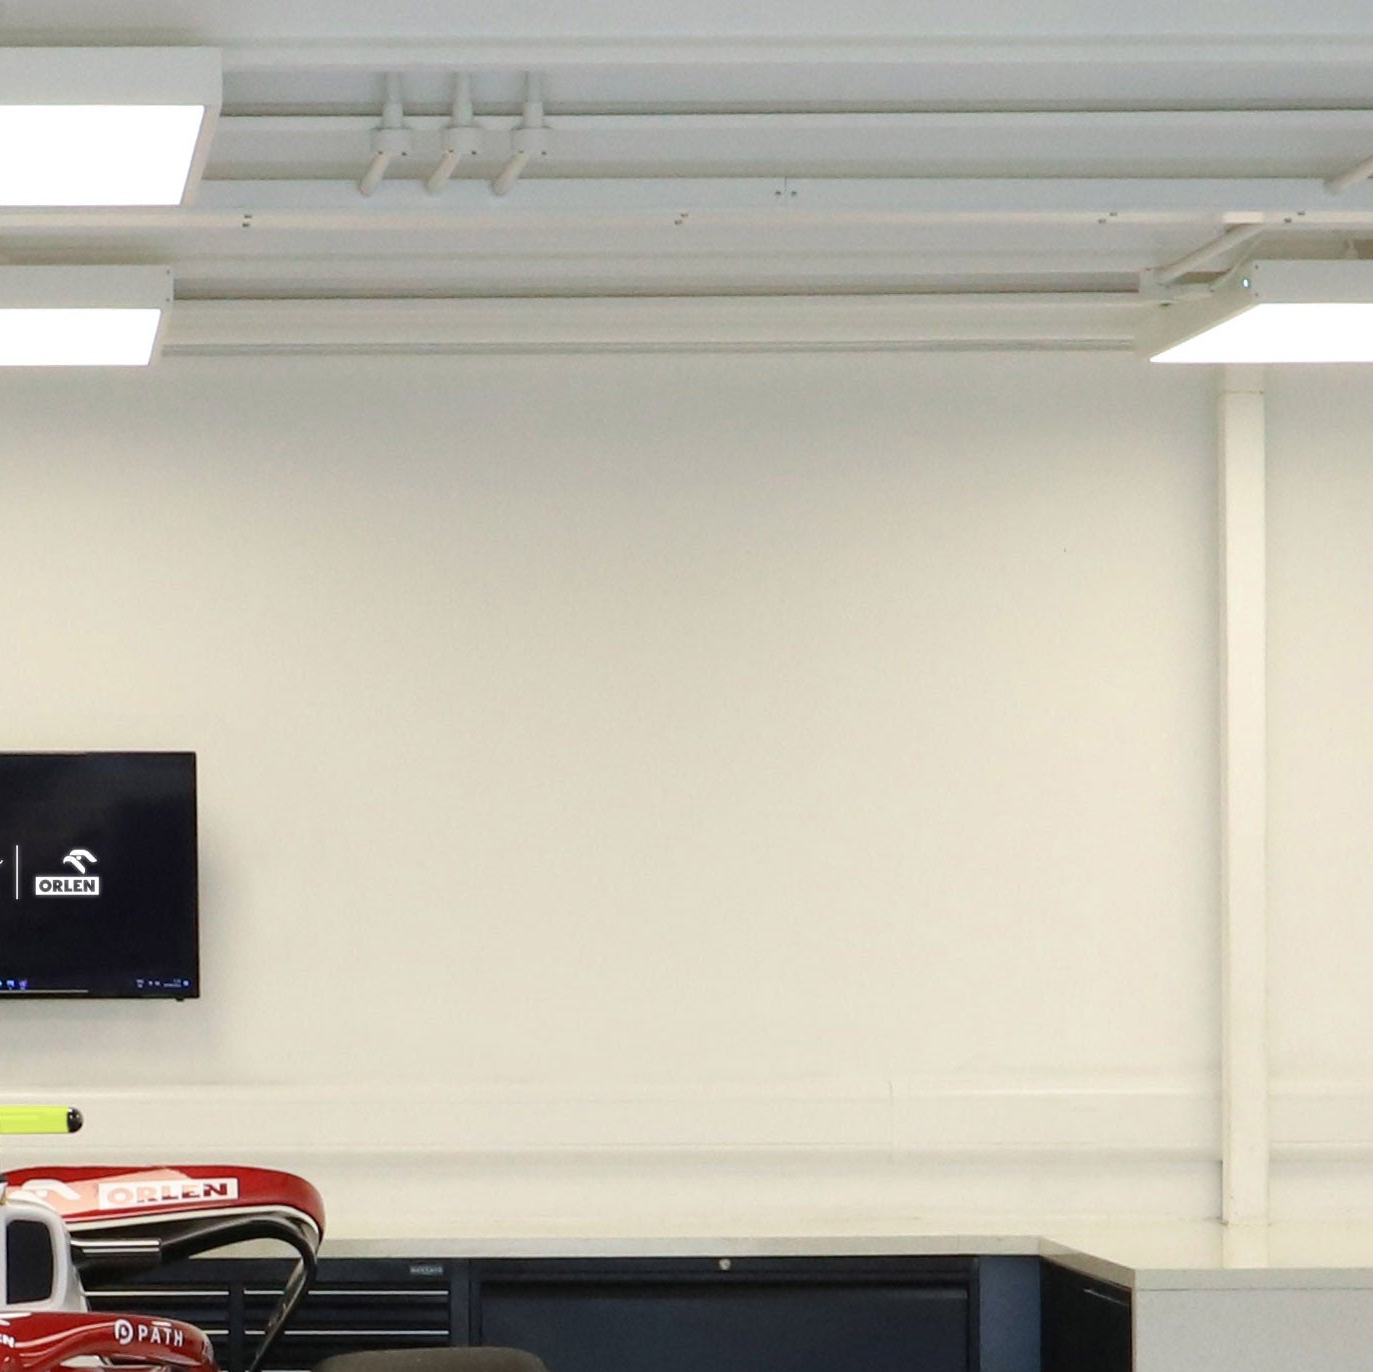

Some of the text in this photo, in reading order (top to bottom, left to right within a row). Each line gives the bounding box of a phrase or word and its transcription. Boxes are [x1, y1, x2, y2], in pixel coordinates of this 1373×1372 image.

[38, 878, 96, 894] ORLEN
[106, 1182, 229, 1206] ORLEN
[137, 1324, 185, 1347] PATH
